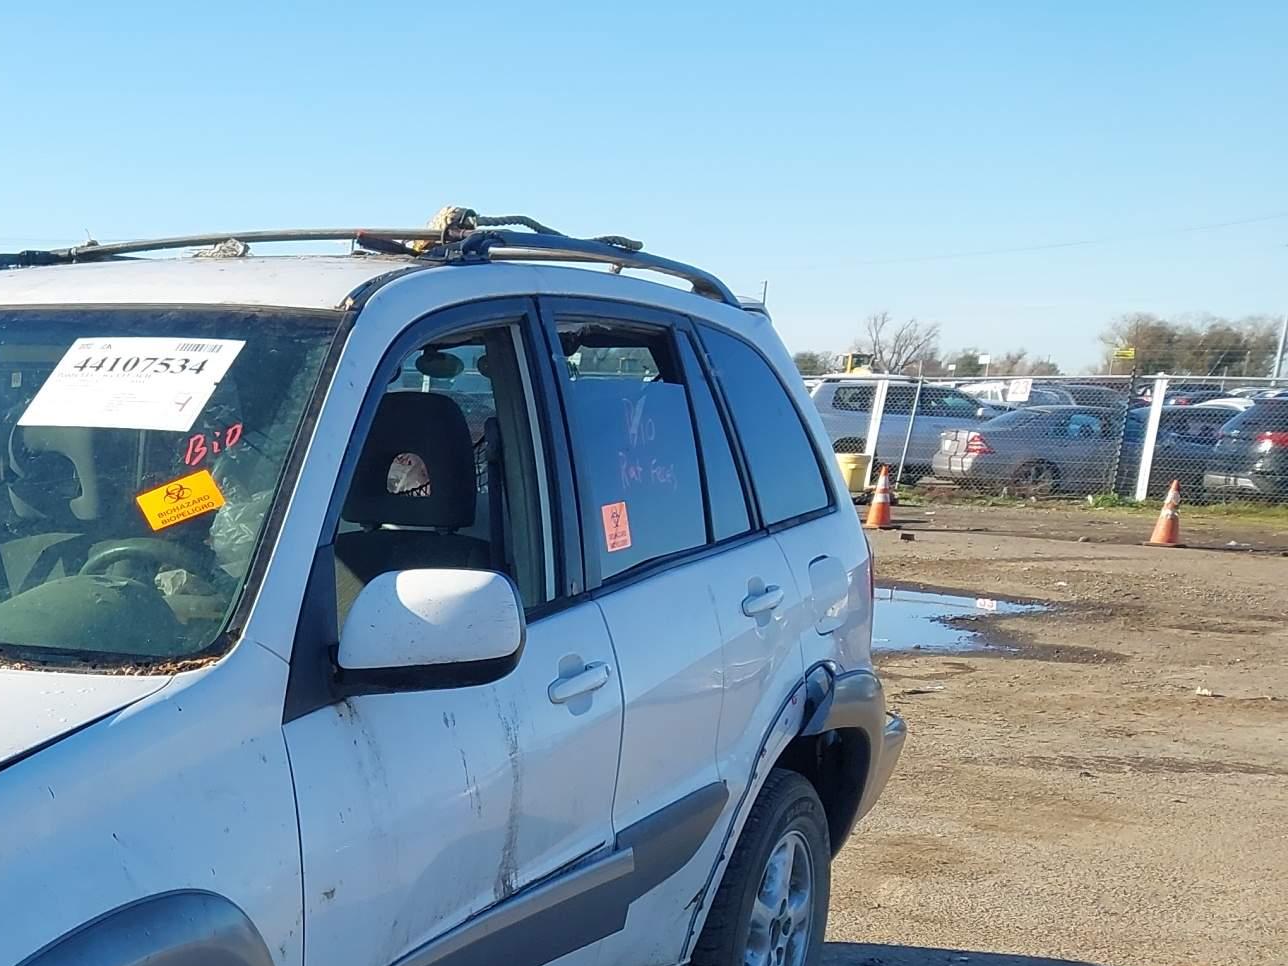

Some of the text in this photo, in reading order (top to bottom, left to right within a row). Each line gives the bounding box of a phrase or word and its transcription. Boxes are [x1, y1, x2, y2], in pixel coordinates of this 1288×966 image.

[73, 356, 208, 375] 44107534
[157, 494, 210, 518] BIOHAZARD
[161, 501, 215, 525] BIOPELIGRO
